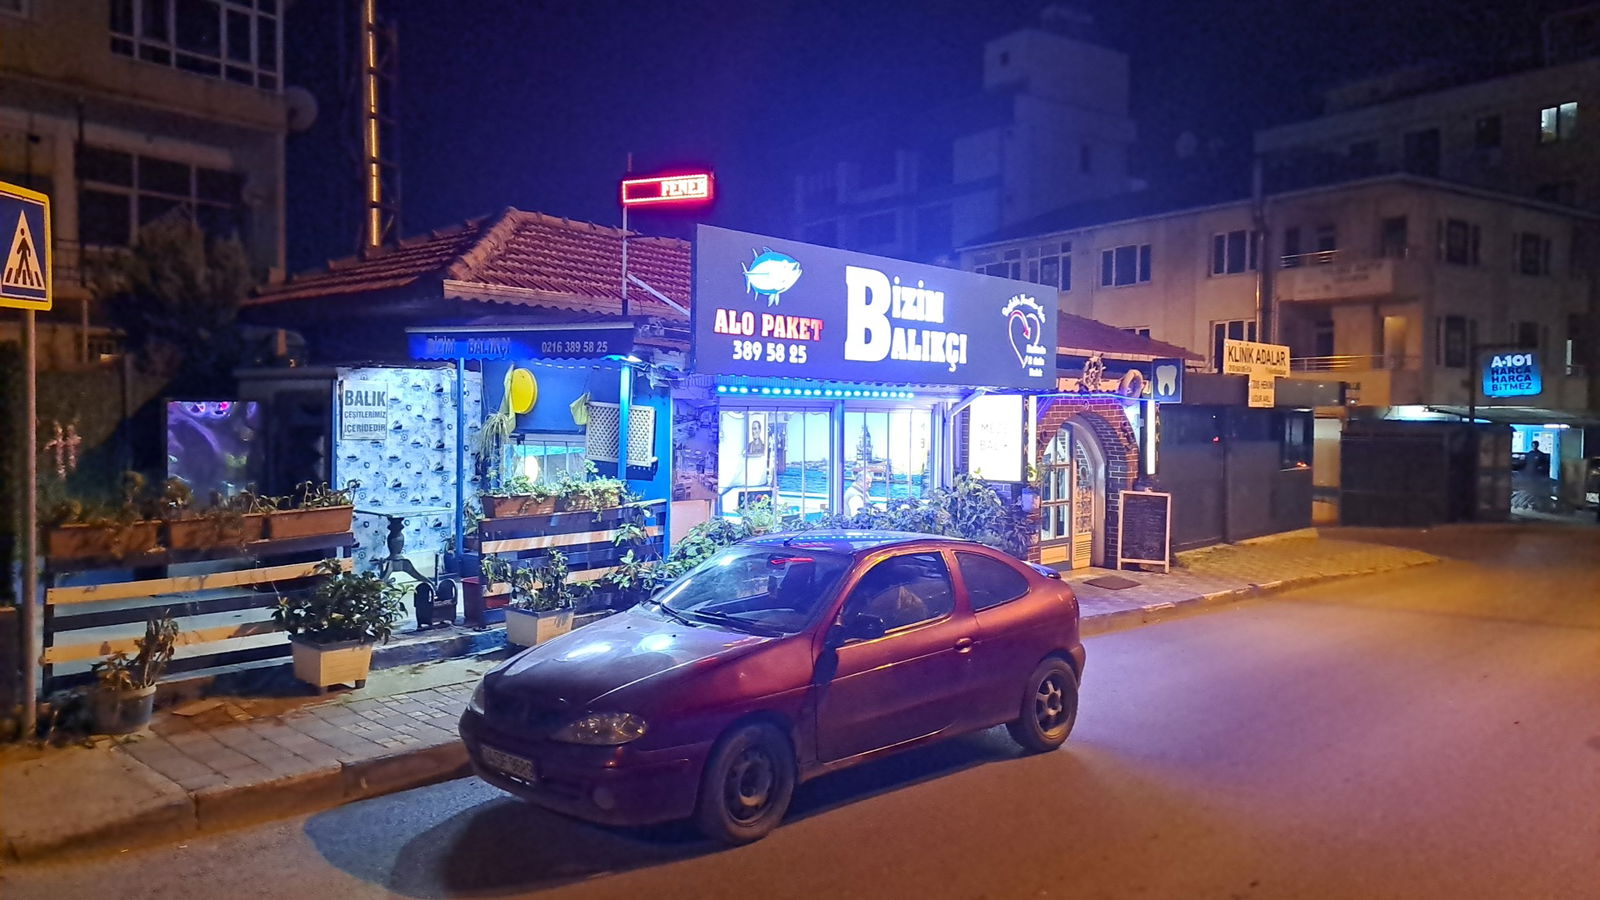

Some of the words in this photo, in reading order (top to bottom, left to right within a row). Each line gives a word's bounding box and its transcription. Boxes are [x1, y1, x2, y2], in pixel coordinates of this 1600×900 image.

[714, 308, 755, 336] ALO
[761, 313, 823, 341] PAKET
[541, 341, 563, 353] 0216
[564, 341, 581, 353] 389
[583, 341, 594, 353] 58
[596, 341, 608, 353] 25
[733, 339, 762, 361] 389
[766, 342, 785, 362] 58
[789, 344, 807, 364] 25
[1228, 343, 1254, 363] KLİNİK
[1255, 349, 1286, 366] ADALAR
[1491, 367, 1531, 375] HARCA
[1491, 374, 1531, 383] HARCA
[345, 390, 386, 406] BALIK
